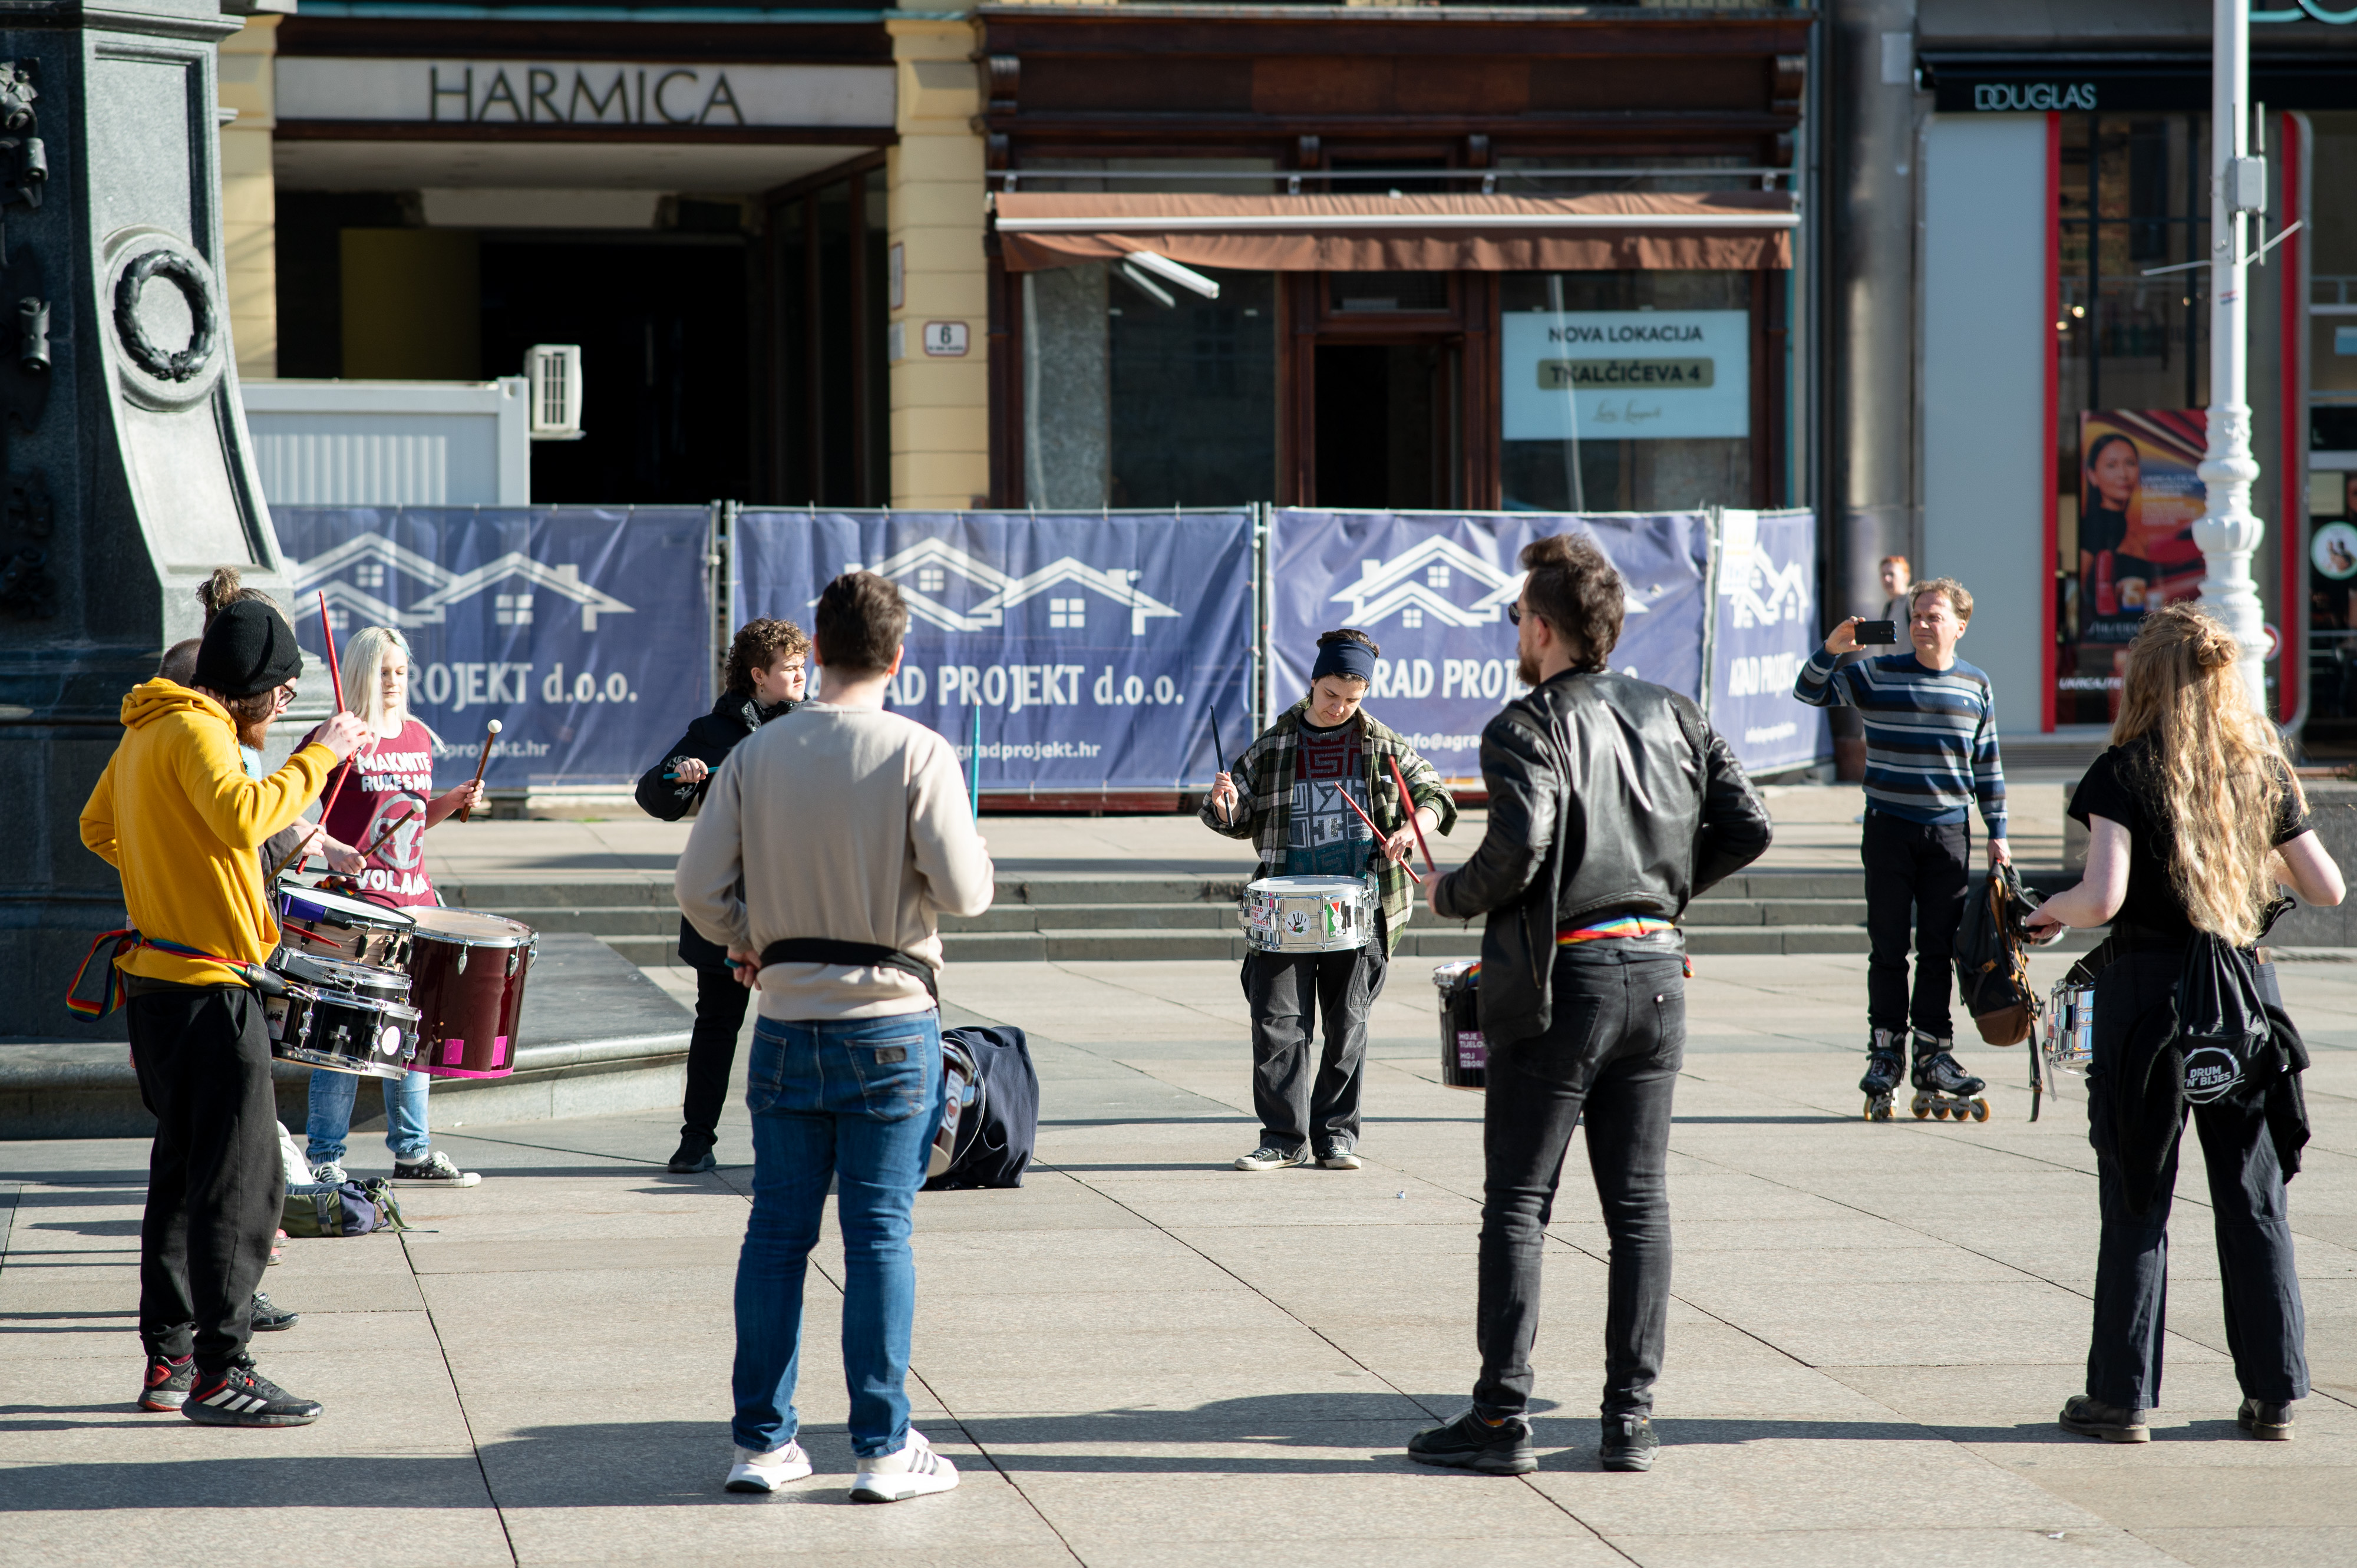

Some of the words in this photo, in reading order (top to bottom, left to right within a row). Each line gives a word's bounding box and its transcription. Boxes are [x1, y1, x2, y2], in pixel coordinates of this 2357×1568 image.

[429, 66, 745, 124] HARMICA
[1975, 82, 2098, 111] DOUGLAS
[940, 325, 951, 345] 6
[1548, 325, 1604, 342] NOVA
[1608, 325, 1704, 342] LOKACIJA
[1689, 365, 1700, 381] 4
[407, 661, 533, 713] ROJEKT
[542, 662, 639, 704] d.o.o.
[937, 663, 1085, 714] PROJEKT
[1093, 665, 1185, 706] d.o.o.
[1363, 658, 1435, 699] RAD
[356, 751, 432, 774] MAKNITE
[2190, 1065, 2221, 1079] DRUM
[2200, 1071, 2231, 1086] BIJES
